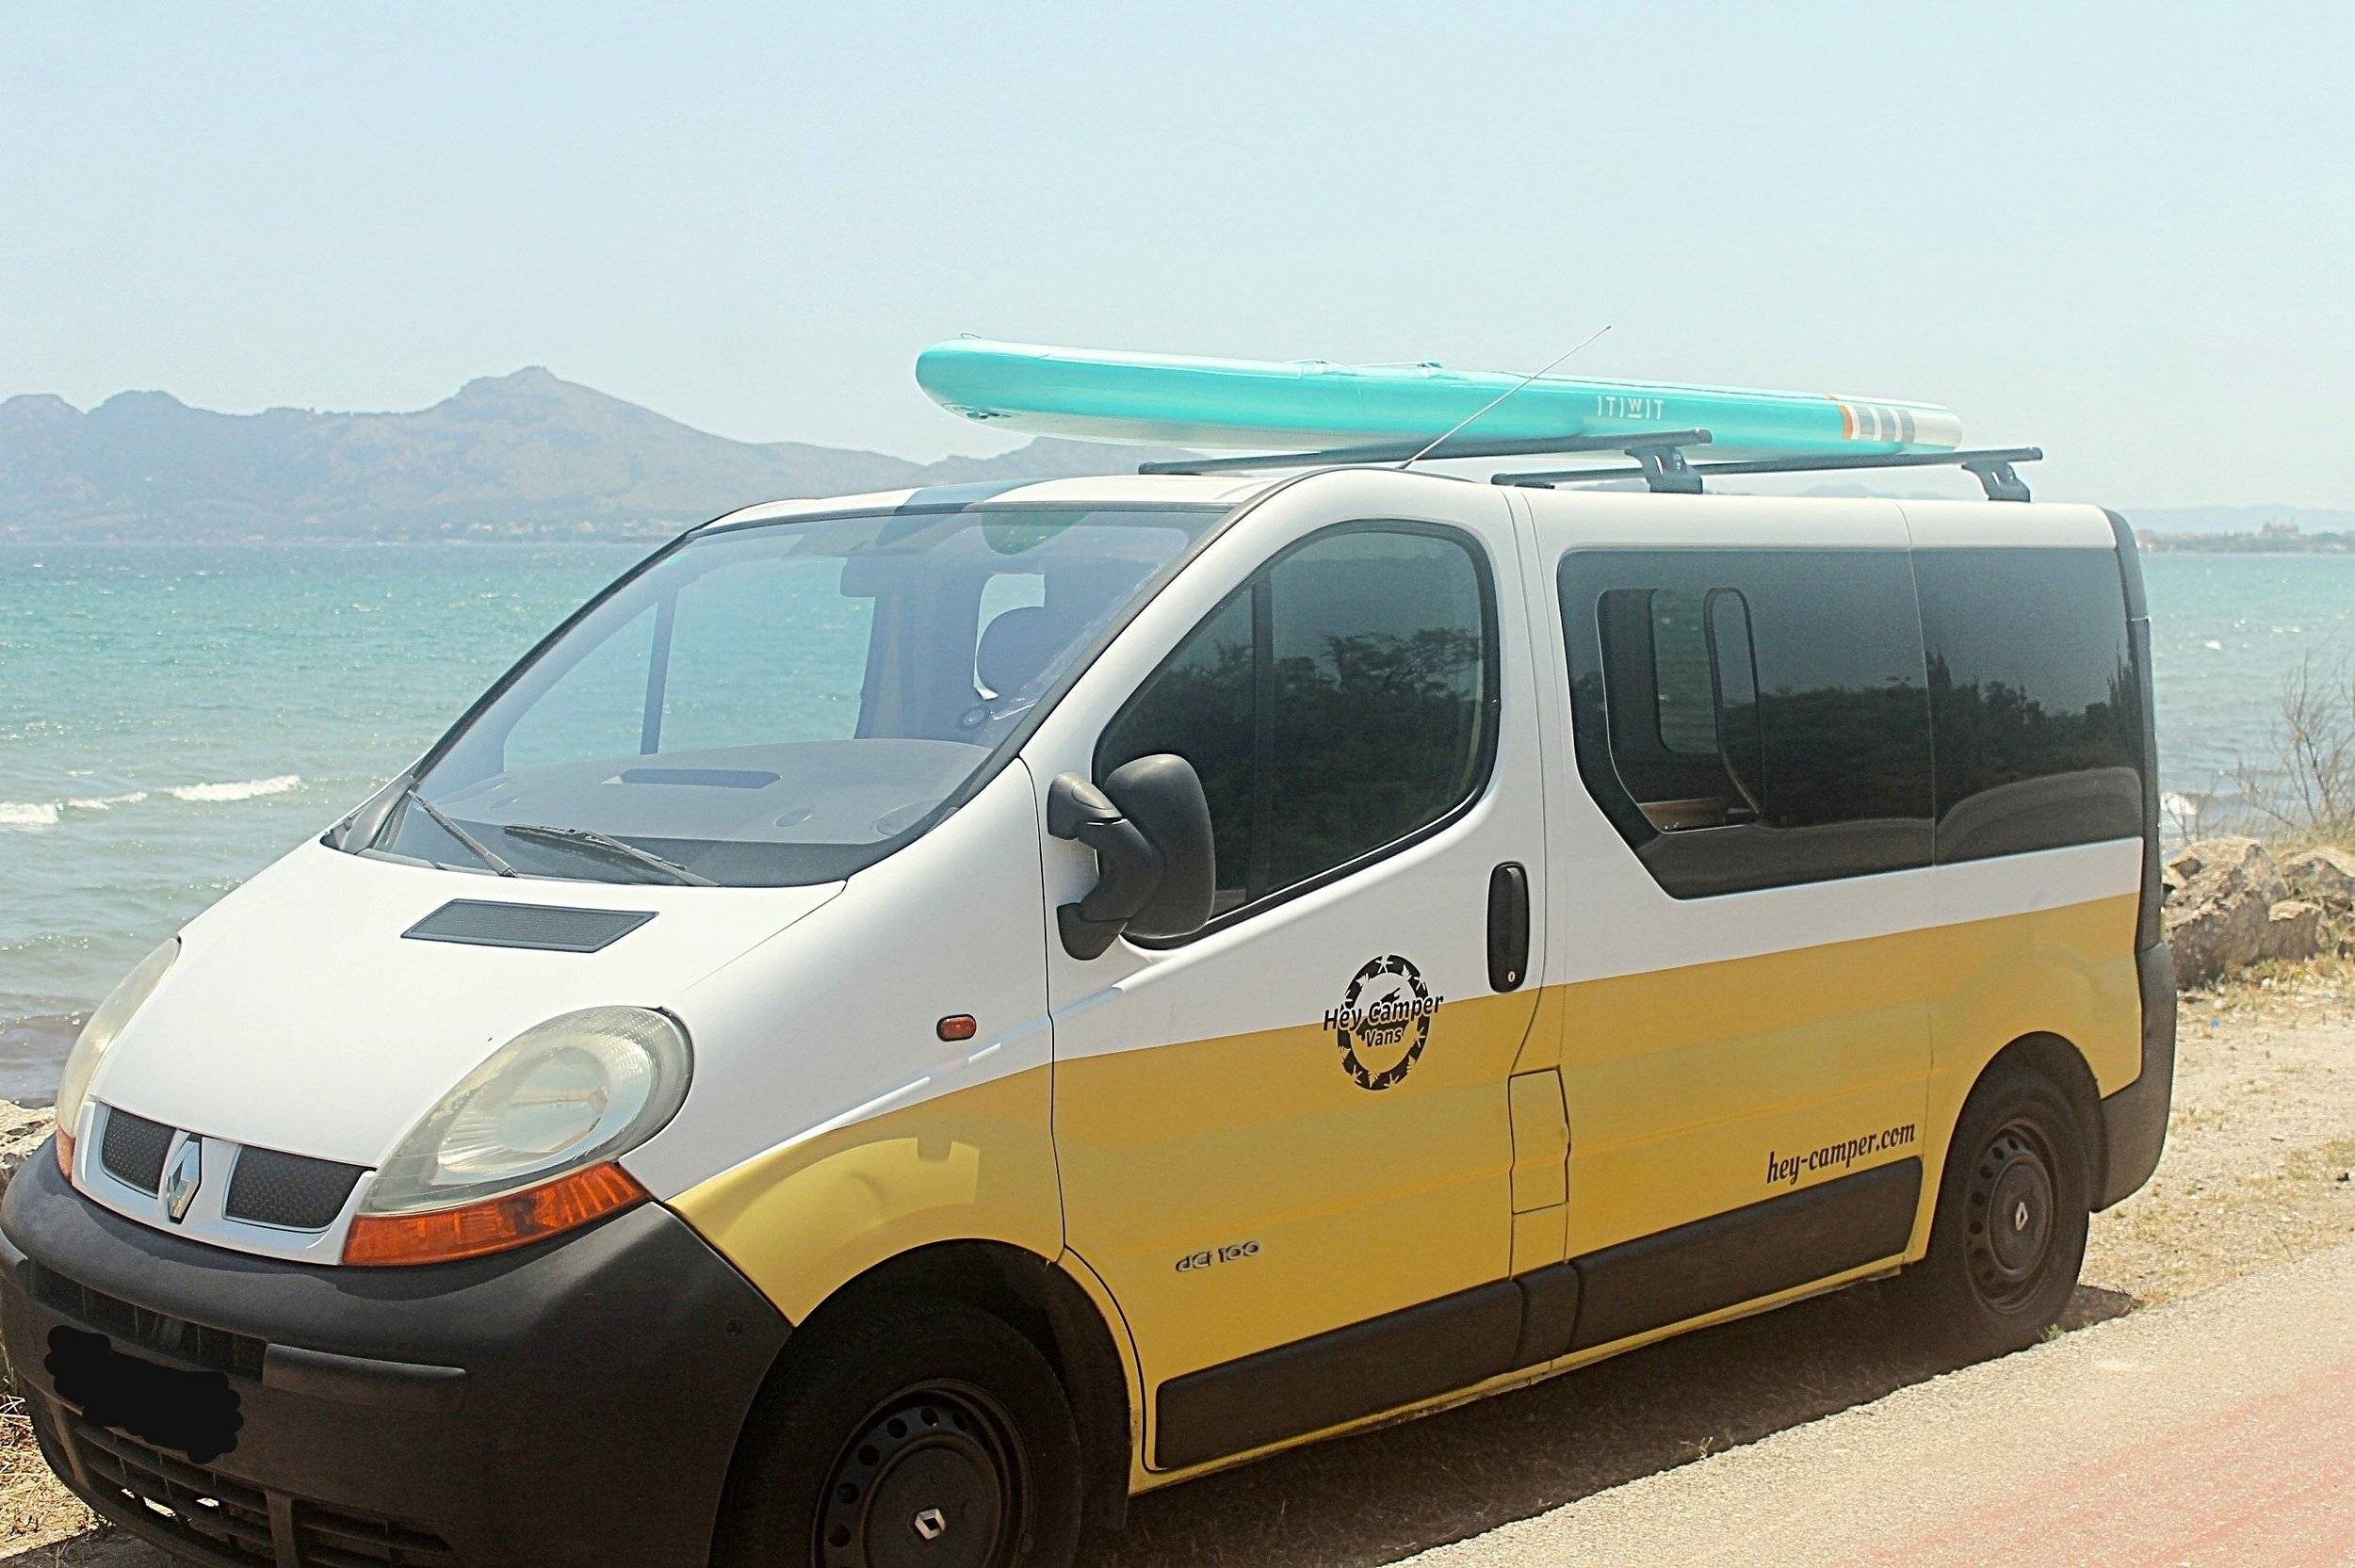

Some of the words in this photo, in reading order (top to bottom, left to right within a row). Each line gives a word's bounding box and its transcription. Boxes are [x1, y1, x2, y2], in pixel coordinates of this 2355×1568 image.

[1597, 396, 1665, 420] ITIWIT
[1323, 1008, 1362, 1032] Hey
[1368, 994, 1444, 1024] Camper
[1365, 1027, 1403, 1048] Vans
[1766, 1123, 1915, 1185] hey-camper.com
[1218, 1240, 1261, 1263] 100
